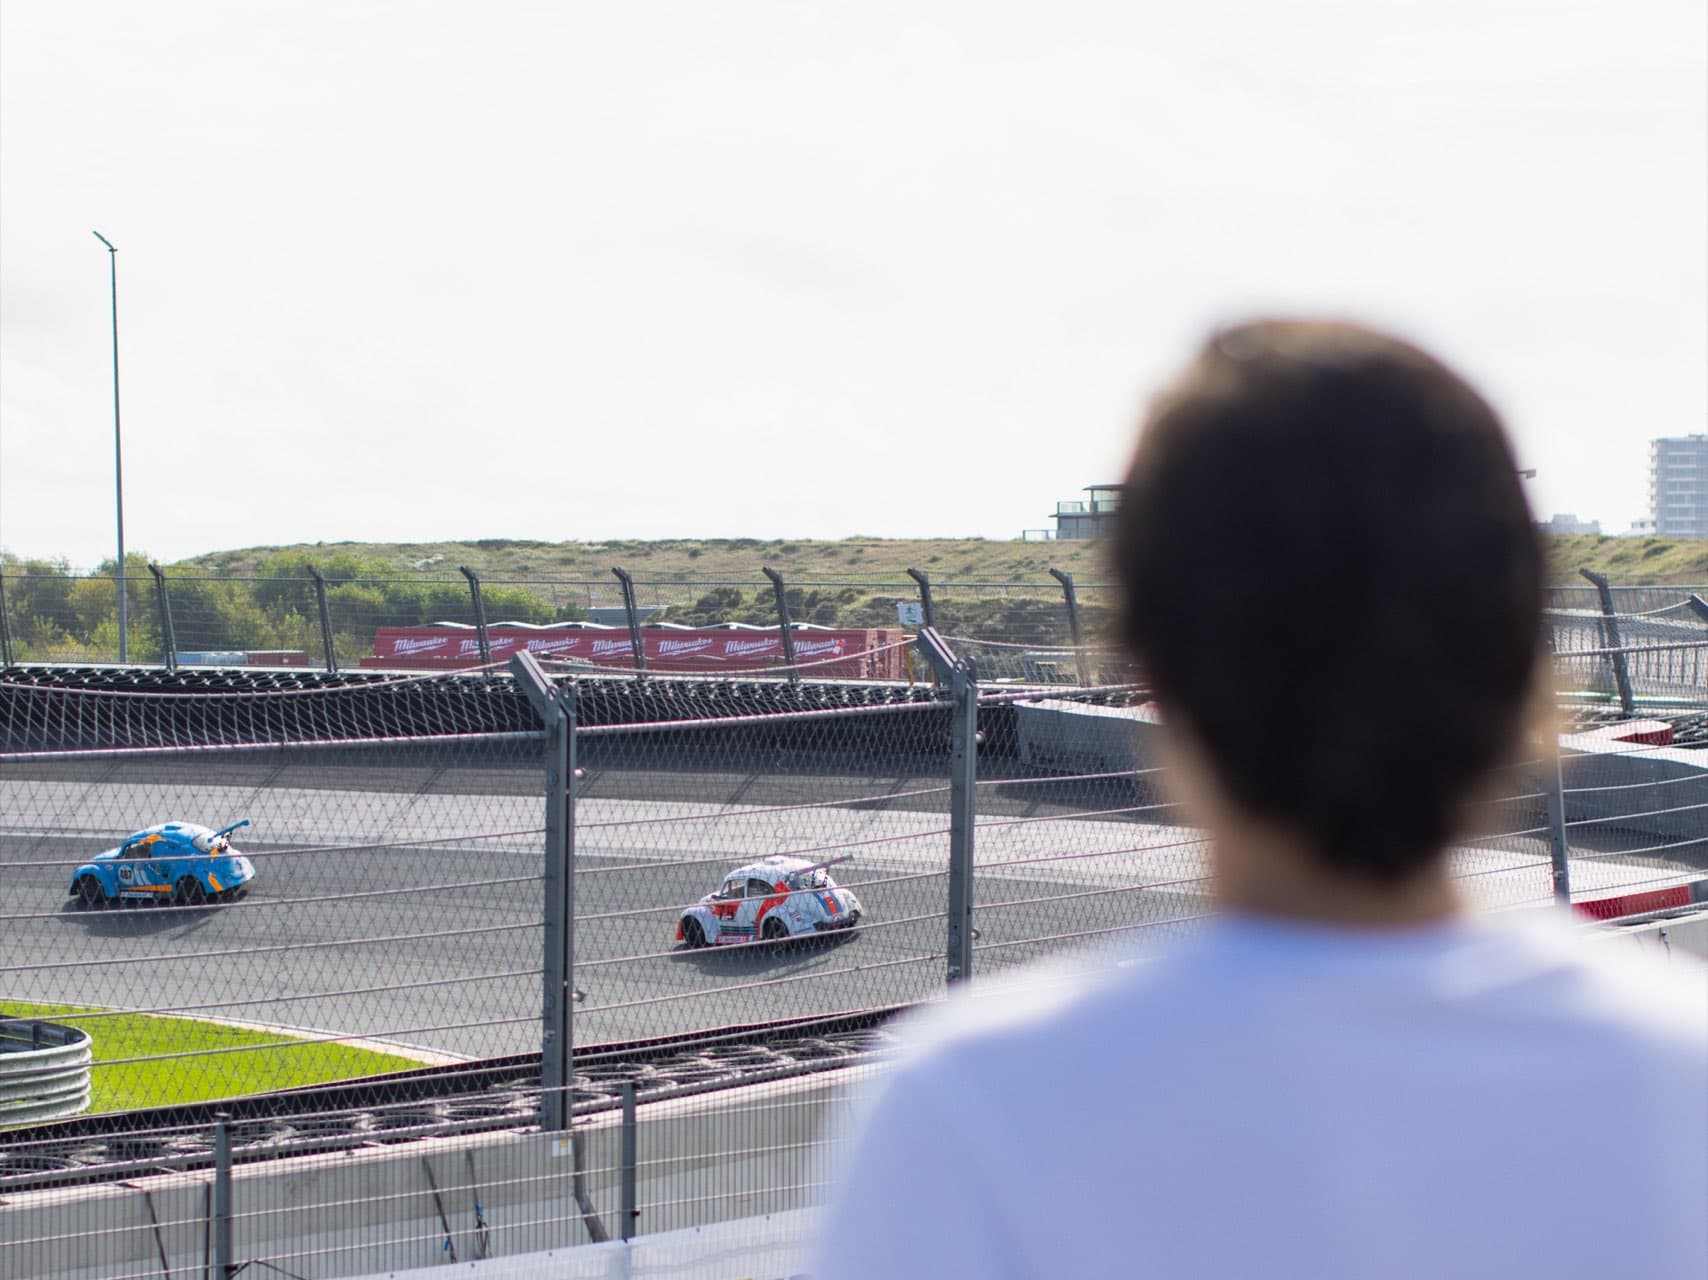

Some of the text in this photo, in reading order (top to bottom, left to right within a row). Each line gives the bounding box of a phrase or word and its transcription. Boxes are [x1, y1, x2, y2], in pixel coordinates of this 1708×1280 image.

[393, 637, 449, 652] Milwaukee
[459, 637, 514, 652] Milukee
[525, 637, 580, 652] Milwaukee
[658, 637, 713, 652] Milwaukee
[724, 637, 779, 652] Milwaukee
